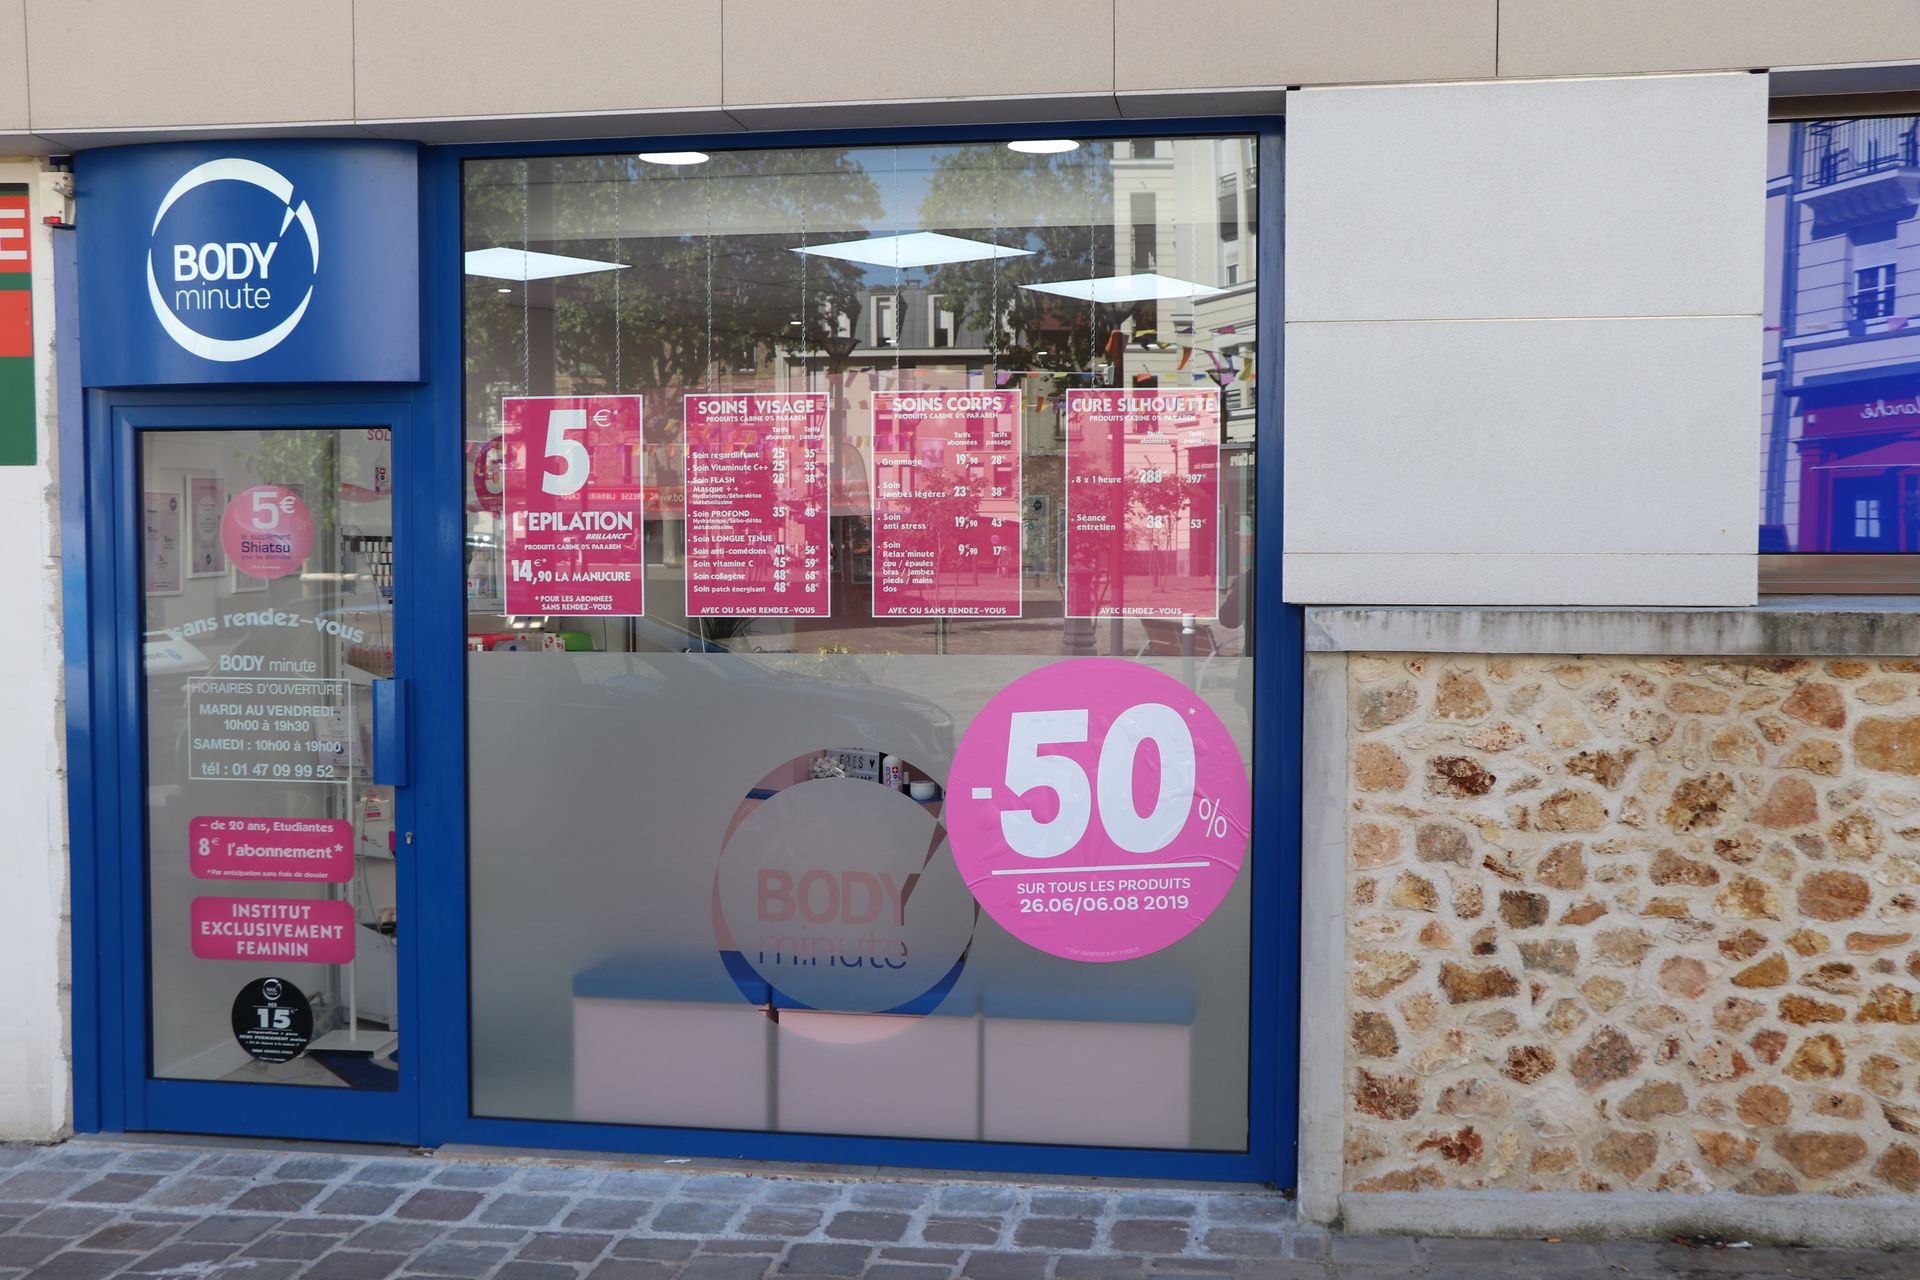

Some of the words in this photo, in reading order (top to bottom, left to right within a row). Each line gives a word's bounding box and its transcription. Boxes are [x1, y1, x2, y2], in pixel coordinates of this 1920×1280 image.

[174, 241, 278, 282] BODY
[176, 281, 271, 310] minute
[698, 401, 748, 414] SOINS
[755, 400, 815, 414] VISAGE
[892, 398, 943, 412] SOINS
[946, 396, 1002, 412] CORPS
[1072, 398, 1112, 412] CURE
[1118, 398, 1214, 412] SILHOUETTE
[710, 476, 736, 484] FLASH
[512, 511, 632, 532] L'EPILATION
[1076, 514, 1106, 522] Séance
[1076, 523, 1116, 531] entretien
[241, 542, 290, 553] Shiatsu
[693, 560, 710, 568] Soin
[712, 560, 746, 568] vitamine
[555, 572, 570, 582] LA
[572, 571, 632, 582] MANUCURE
[882, 568, 899, 576] bras
[908, 568, 934, 576] jambes
[712, 586, 730, 594] patch
[169, 617, 218, 641] sans
[220, 655, 264, 672] BODY
[269, 658, 316, 672] minute
[192, 683, 253, 694] HORAIRES
[258, 684, 344, 696] D'OUVERTURE
[200, 704, 242, 716] MARDI
[246, 704, 264, 716] AU
[266, 705, 334, 717] VENDREDI
[224, 720, 259, 731] 10h00
[262, 720, 270, 731] à
[274, 720, 310, 732] 19h30
[194, 738, 244, 750] SAMEDI
[255, 740, 290, 751] 10h00
[294, 741, 301, 751] à
[305, 741, 341, 752] 19h00
[201, 762, 219, 776] tél
[232, 763, 248, 776] 01
[252, 763, 269, 776] 47
[273, 764, 290, 777] 09
[294, 764, 312, 777] 99
[316, 764, 334, 778] 52
[210, 821, 226, 830] de
[229, 822, 244, 830] 20
[273, 822, 334, 833] Etudiantes
[1016, 882, 1046, 895] SUR
[1048, 881, 1087, 894] TOUS
[1090, 880, 1115, 893] LES
[1118, 878, 1191, 892] PRODUITS
[757, 868, 921, 927] BODY
[232, 904, 311, 920] INSTITUT
[1020, 896, 1139, 916] 26.06/06.08
[1144, 895, 1189, 911] 2019
[201, 922, 344, 939] EXCLUSIVEMENT
[236, 941, 308, 956] FEMININ
[757, 925, 908, 970] minute
